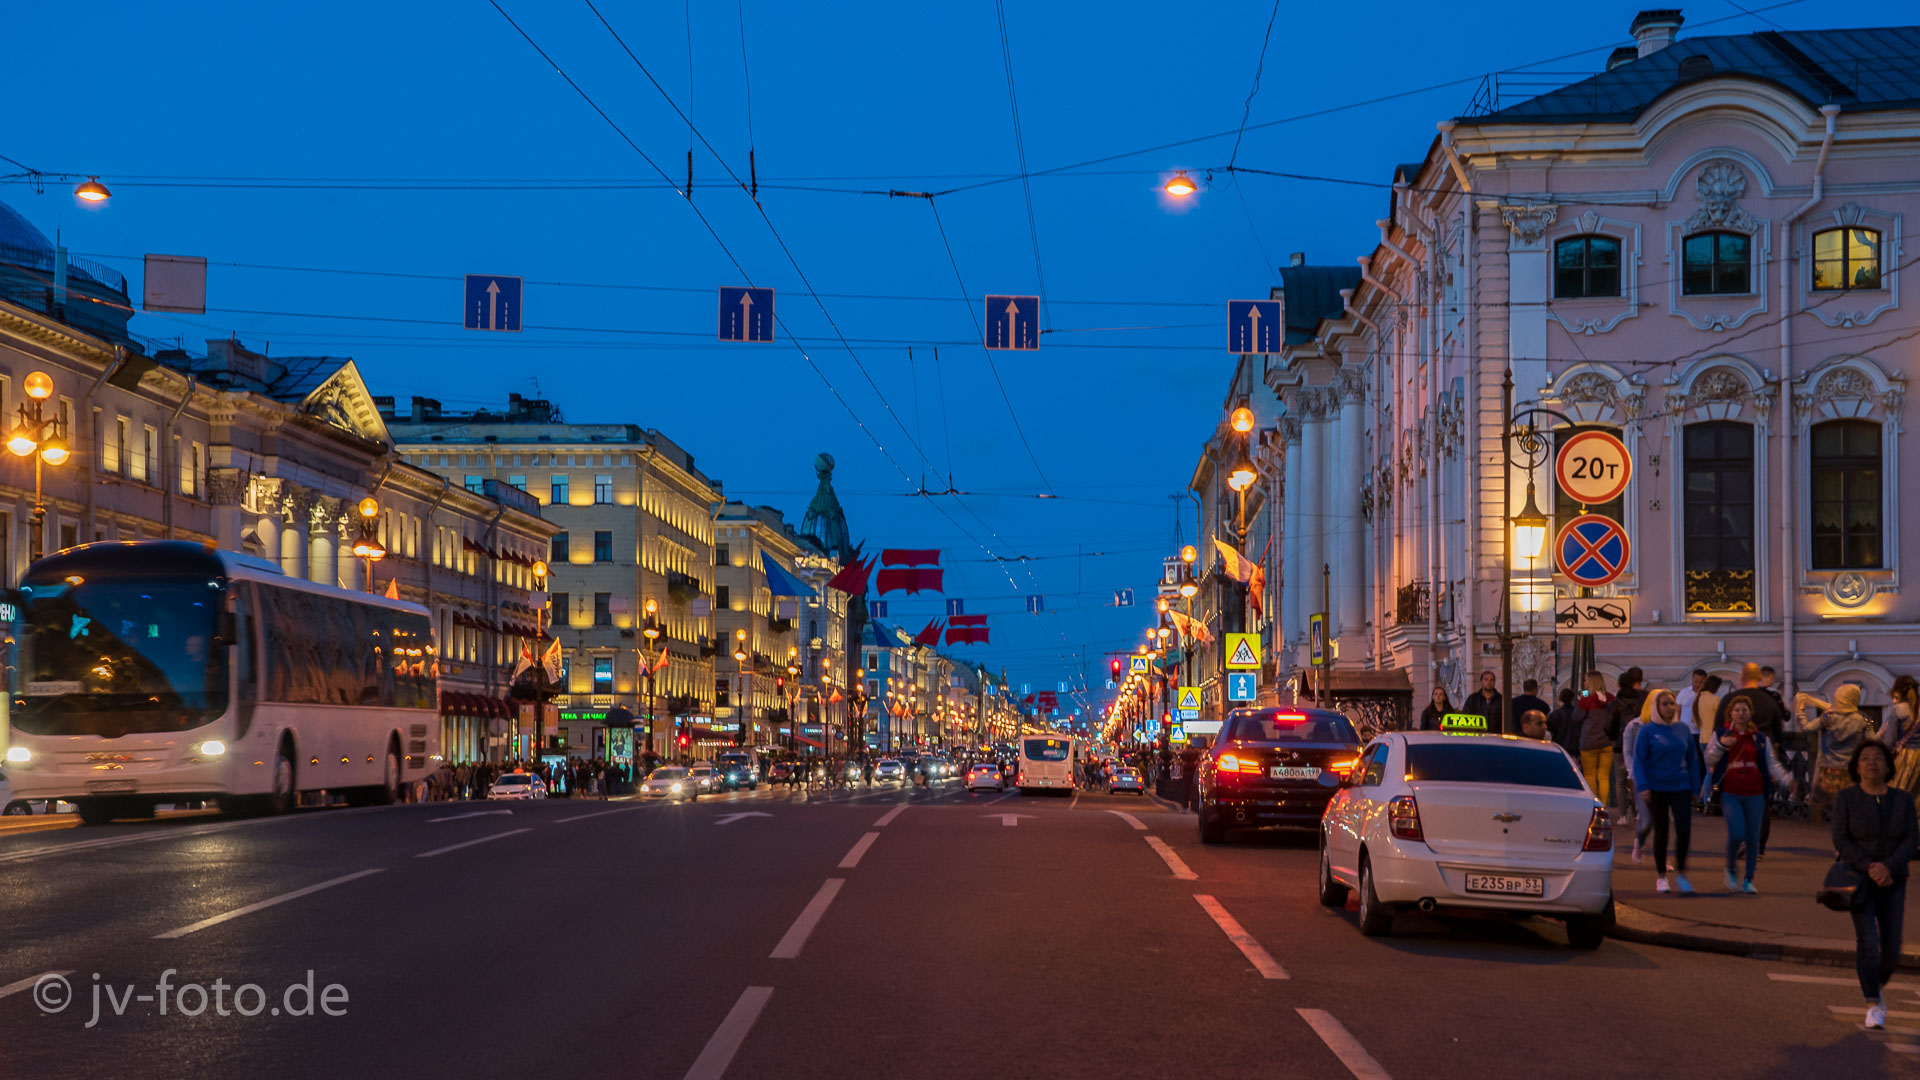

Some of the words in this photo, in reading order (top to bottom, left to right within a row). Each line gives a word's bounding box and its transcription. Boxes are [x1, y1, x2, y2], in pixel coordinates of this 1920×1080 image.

[1450, 716, 1480, 727] TAXI
[1471, 876, 1522, 891] Е235ВР
[1525, 879, 1538, 890] 53
